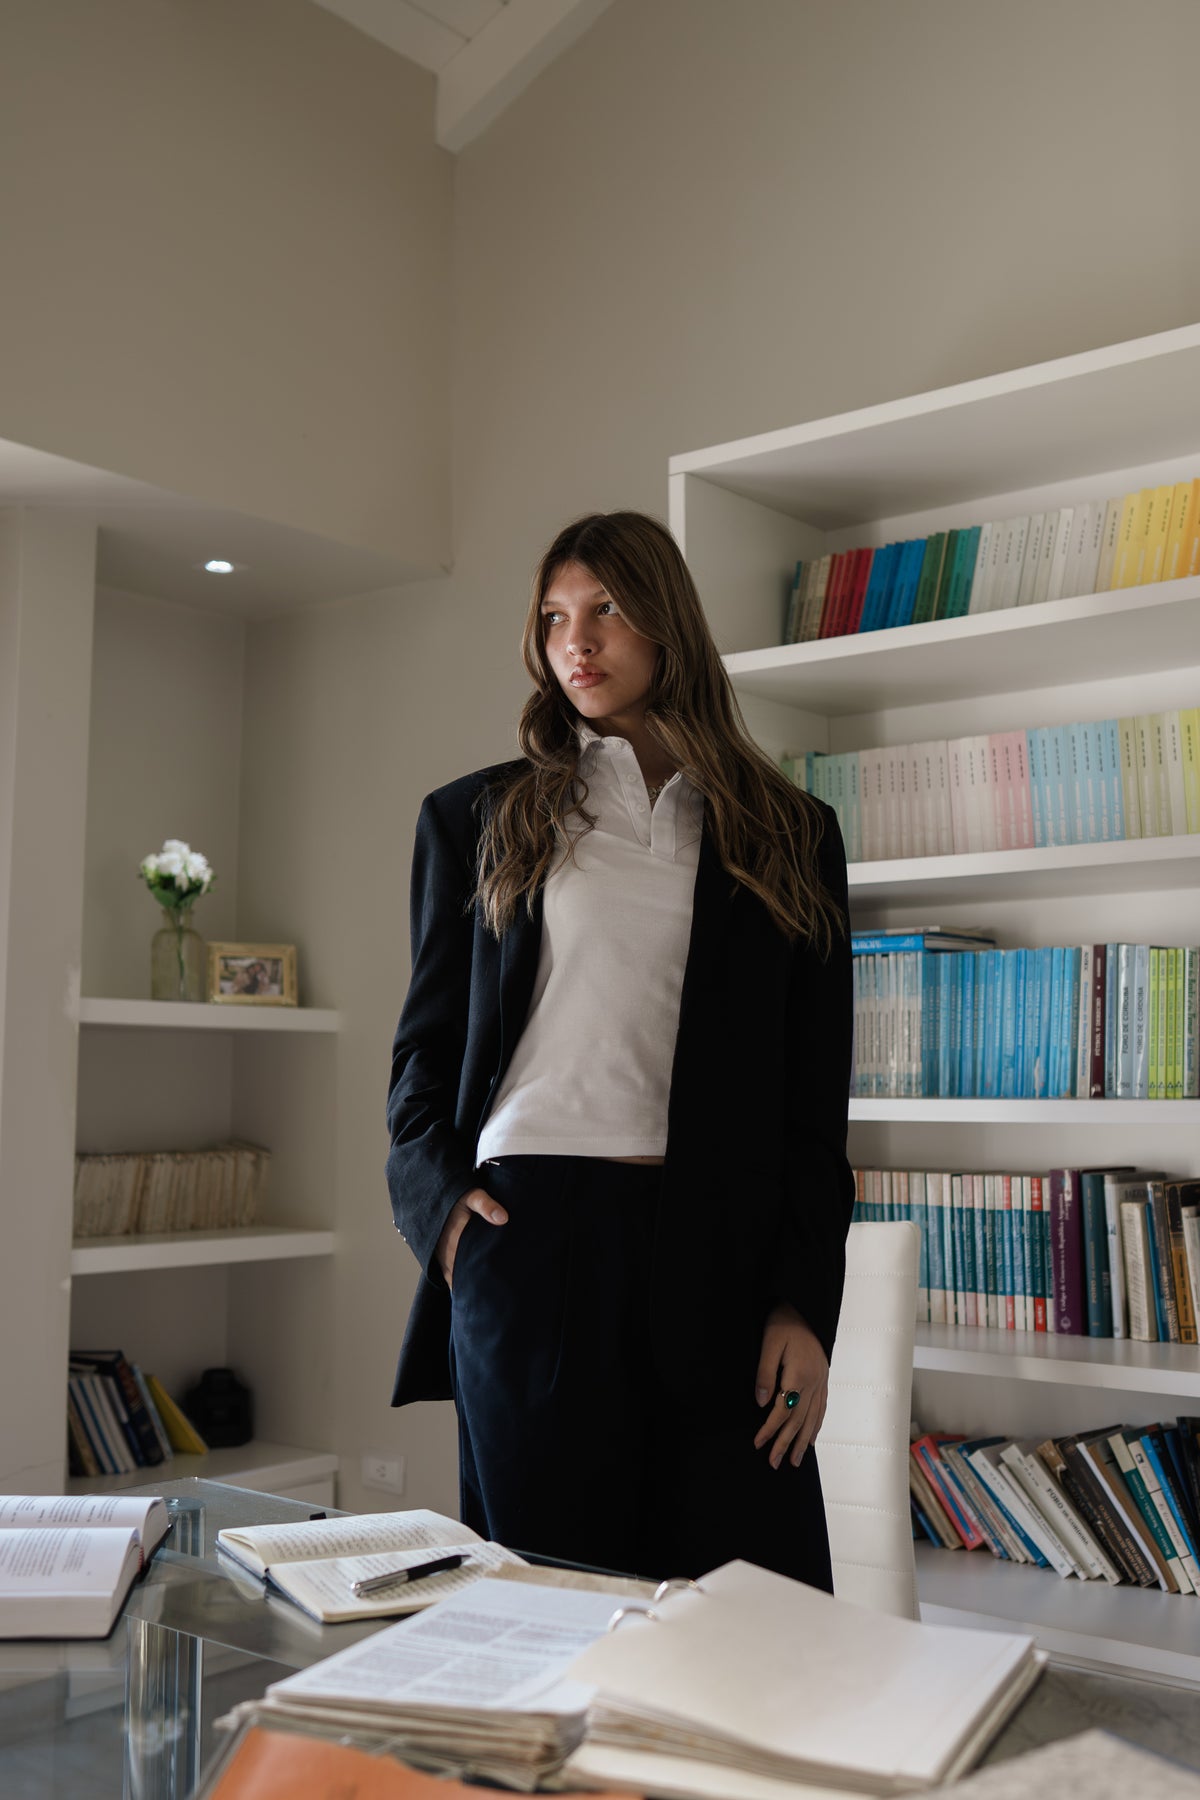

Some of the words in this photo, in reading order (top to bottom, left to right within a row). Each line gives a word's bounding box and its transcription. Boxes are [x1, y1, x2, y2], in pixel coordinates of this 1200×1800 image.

[1123, 1024, 1129, 1033] DE
[1137, 1024, 1143, 1033] DE
[1046, 1487, 1064, 1509] FORO
